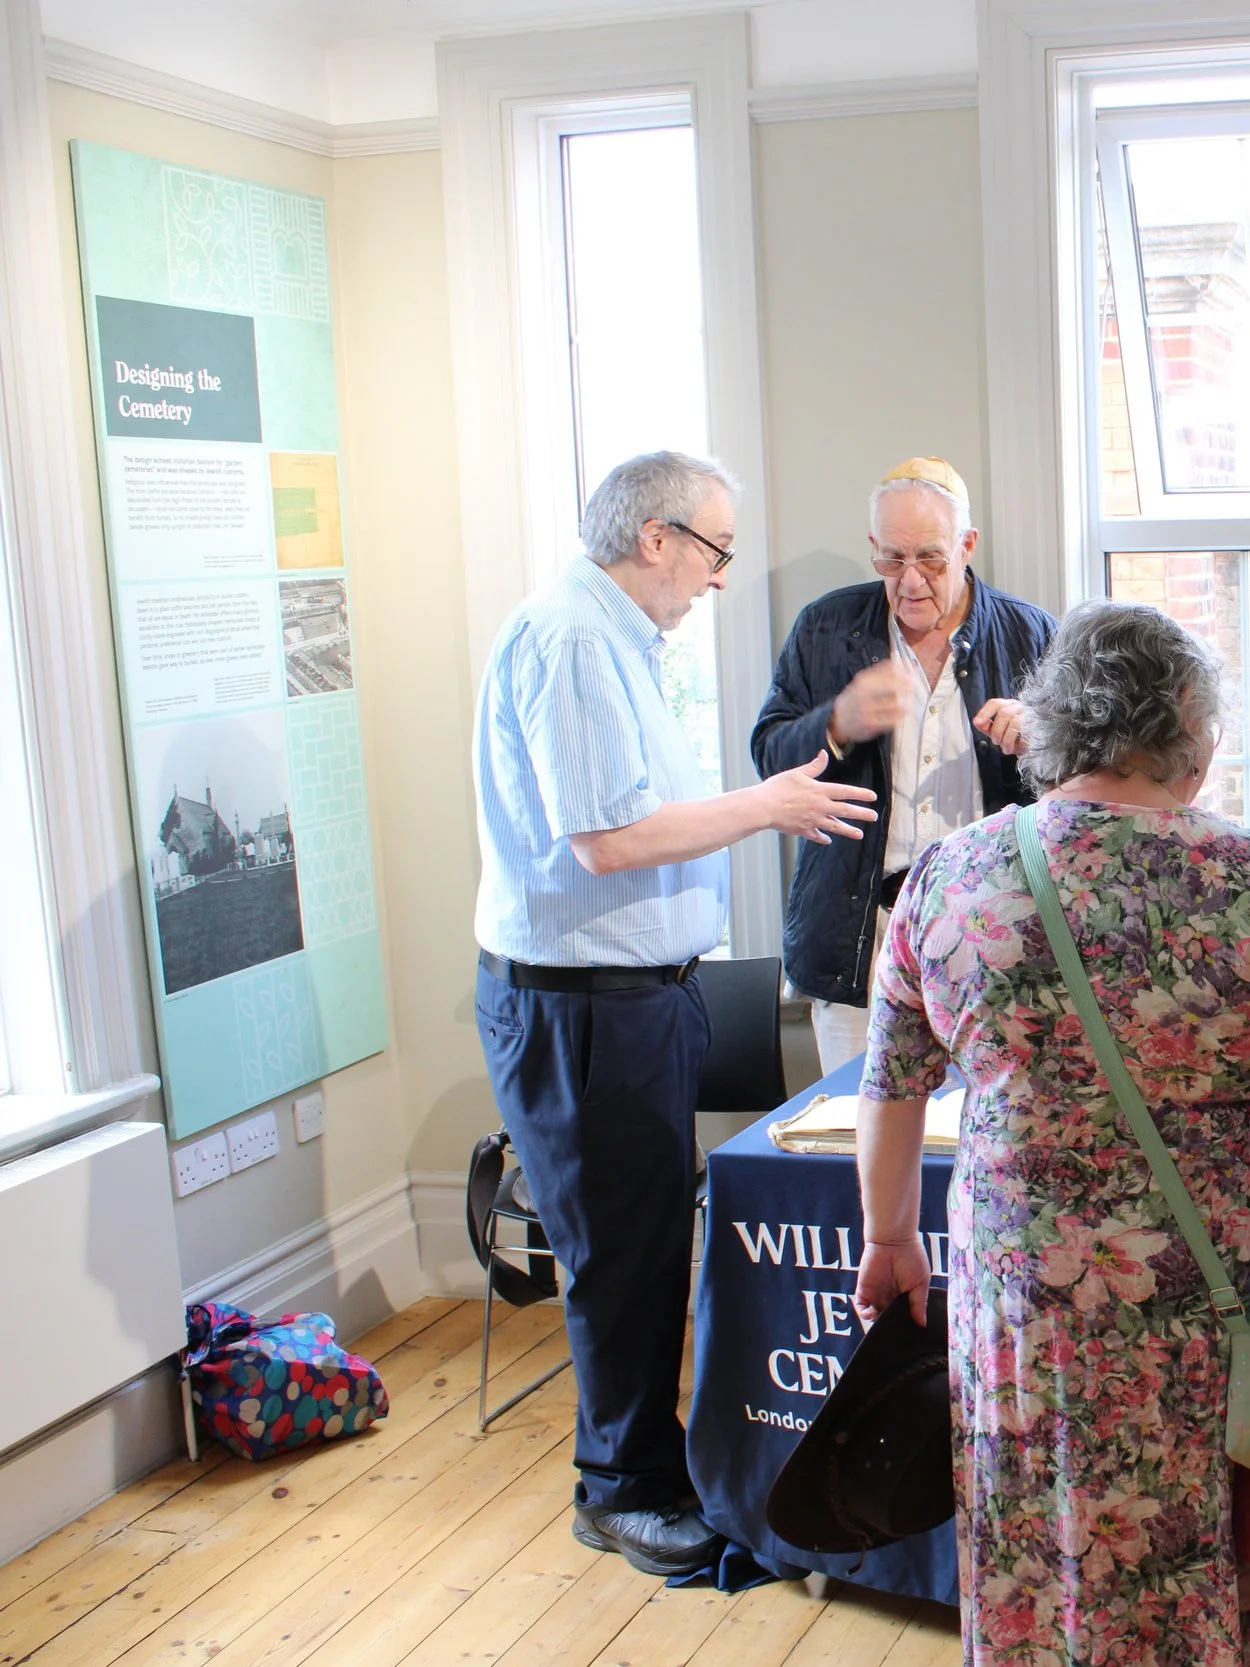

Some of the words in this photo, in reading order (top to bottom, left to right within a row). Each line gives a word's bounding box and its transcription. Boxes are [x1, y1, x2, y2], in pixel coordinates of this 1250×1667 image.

[115, 360, 195, 394] Designing
[197, 368, 222, 392] the
[118, 394, 193, 426] Cemetery
[134, 456, 152, 465] design
[745, 1404, 813, 1432] Londo
